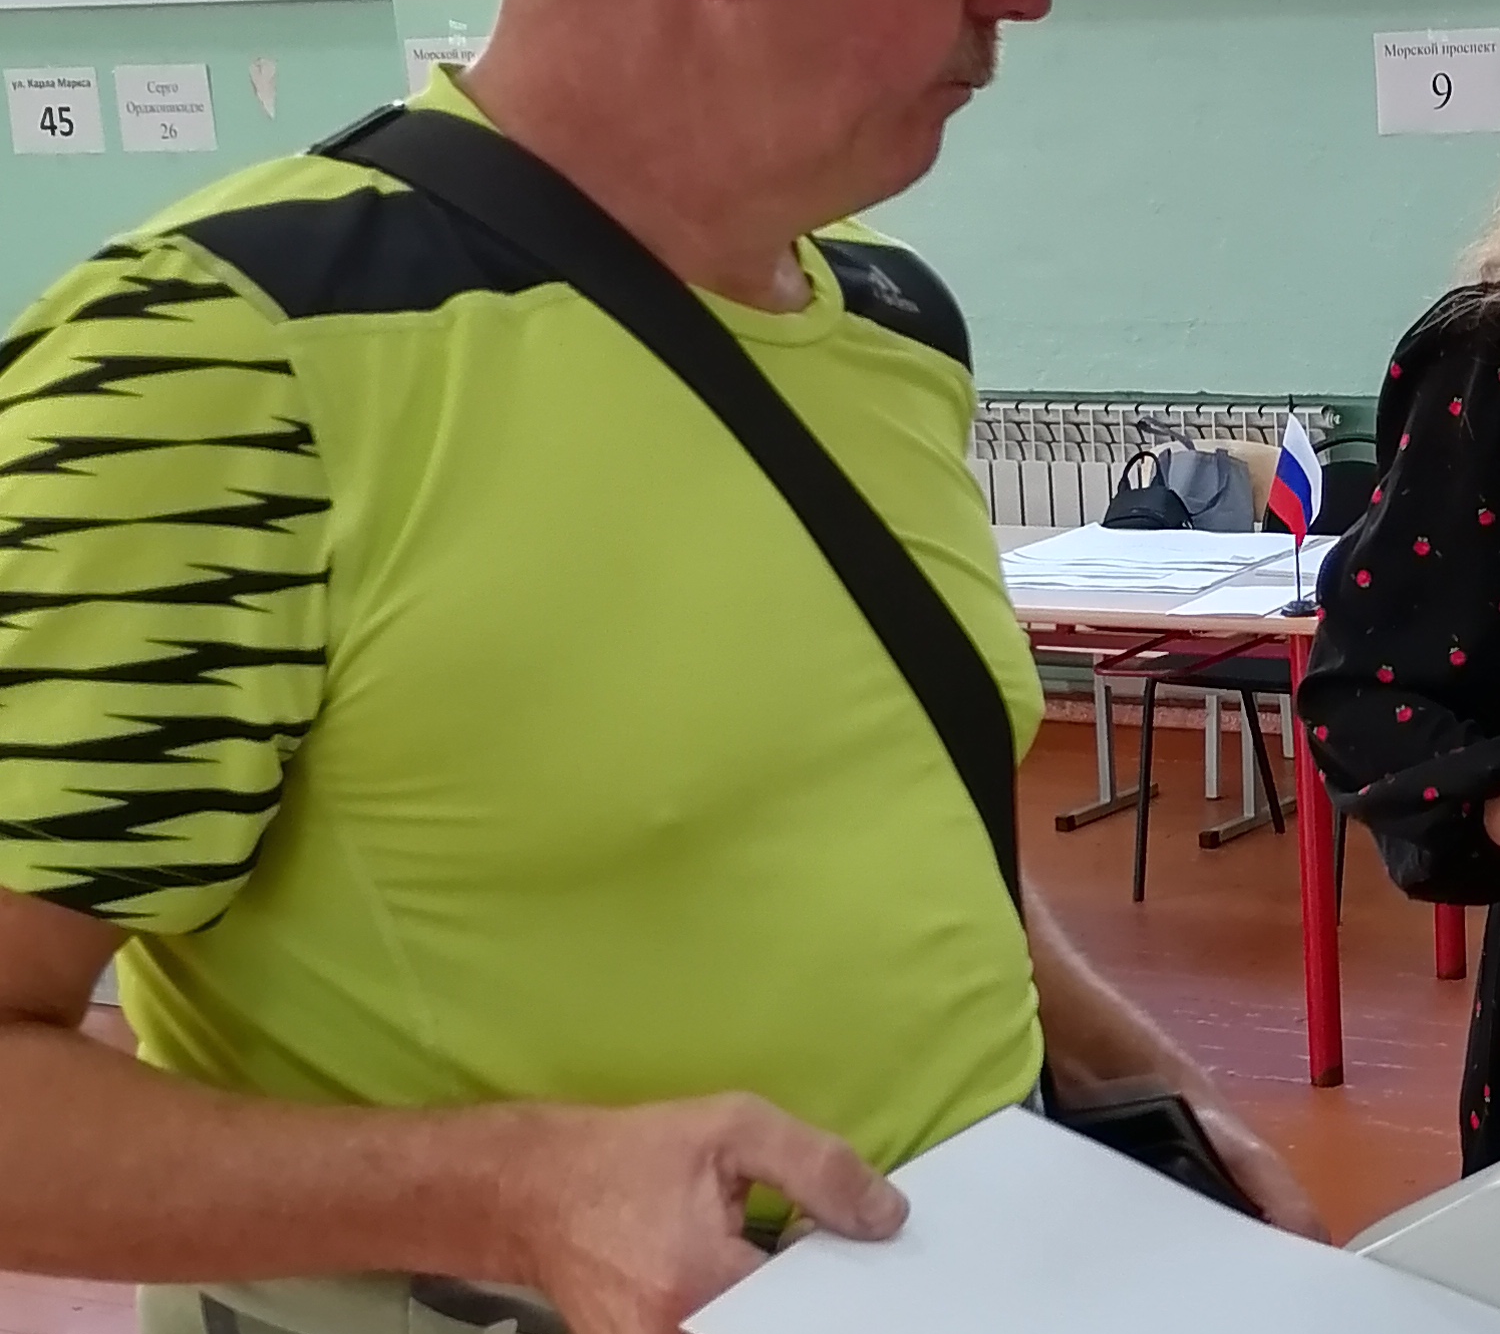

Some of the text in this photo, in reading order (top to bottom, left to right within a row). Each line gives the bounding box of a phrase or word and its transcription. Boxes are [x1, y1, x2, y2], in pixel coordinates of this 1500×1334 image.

[413, 49, 459, 60] Морской
[1383, 42, 1496, 59] Морской проспект
[147, 80, 179, 97] Серго
[1432, 72, 1453, 110] 9
[40, 106, 74, 137] 45
[160, 123, 178, 140] 26
